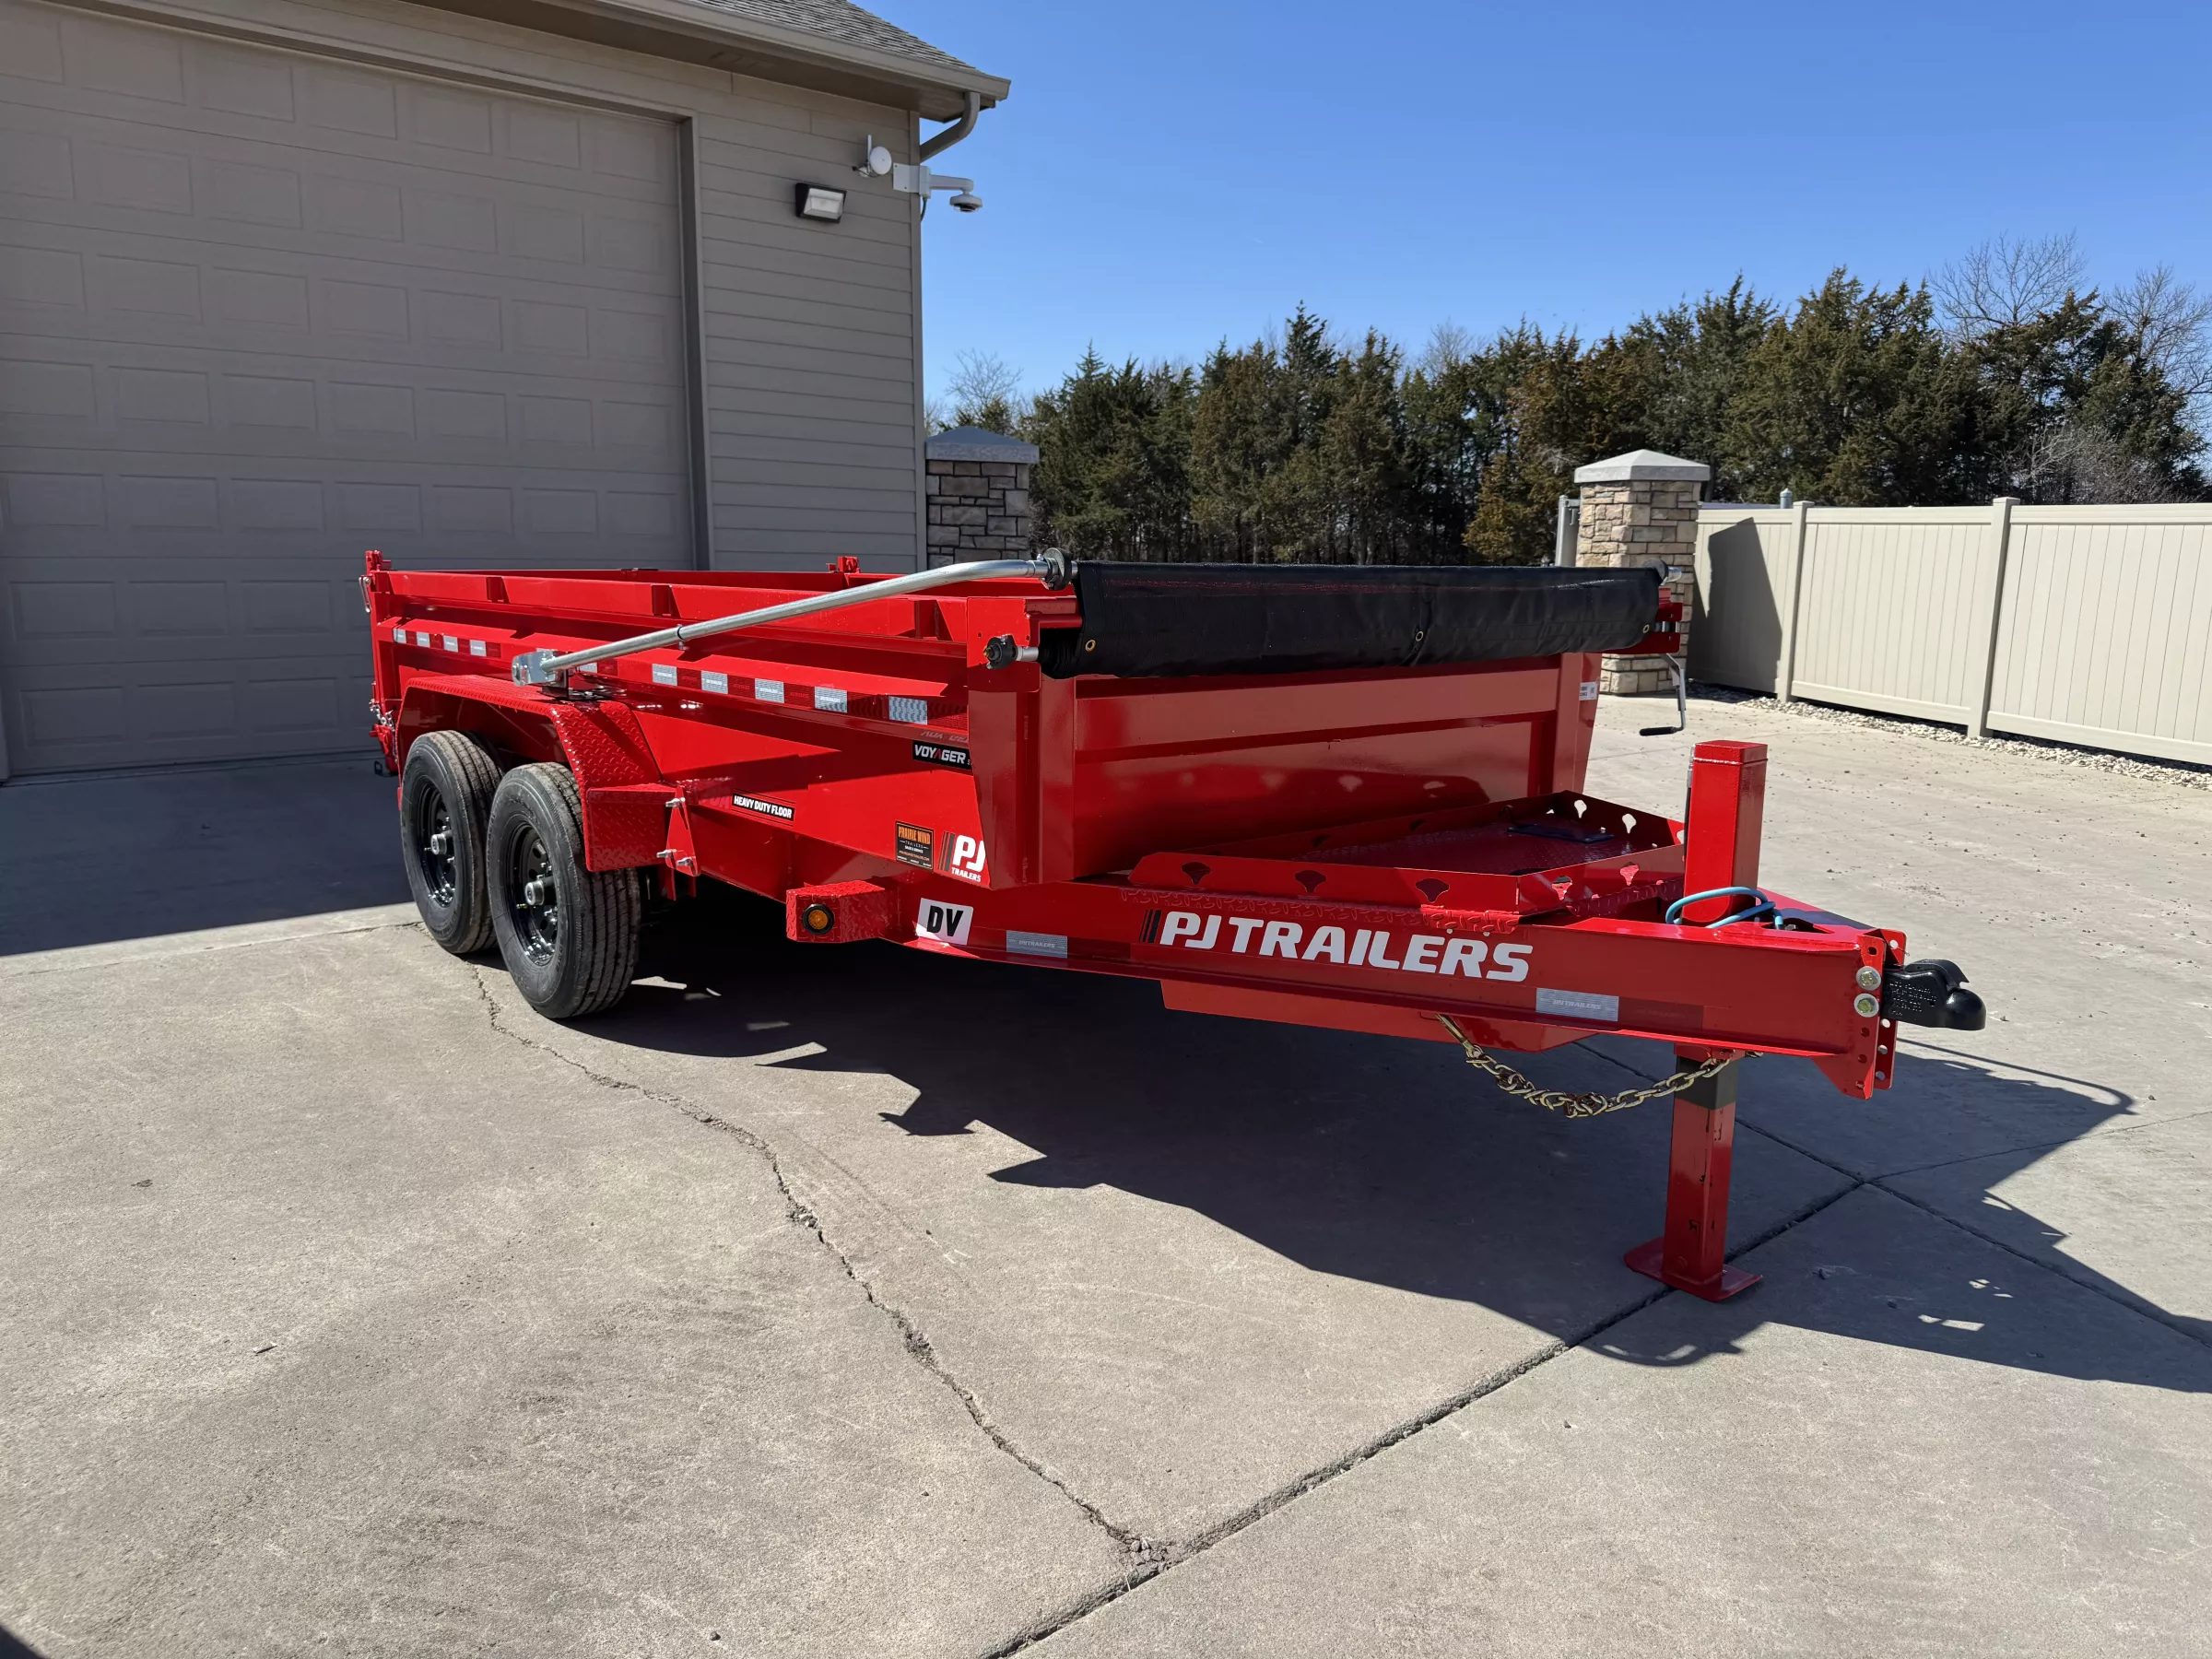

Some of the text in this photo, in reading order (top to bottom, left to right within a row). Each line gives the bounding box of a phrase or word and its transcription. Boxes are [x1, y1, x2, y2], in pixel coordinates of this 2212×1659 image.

[914, 744, 967, 764] VOYAGER
[734, 794, 793, 818] HEAVY DUTY FLOOR
[952, 834, 986, 873] PJ
[951, 867, 981, 881] TRAILERS
[926, 905, 964, 937] DV
[1159, 911, 1534, 982] PJ TRAILERS
